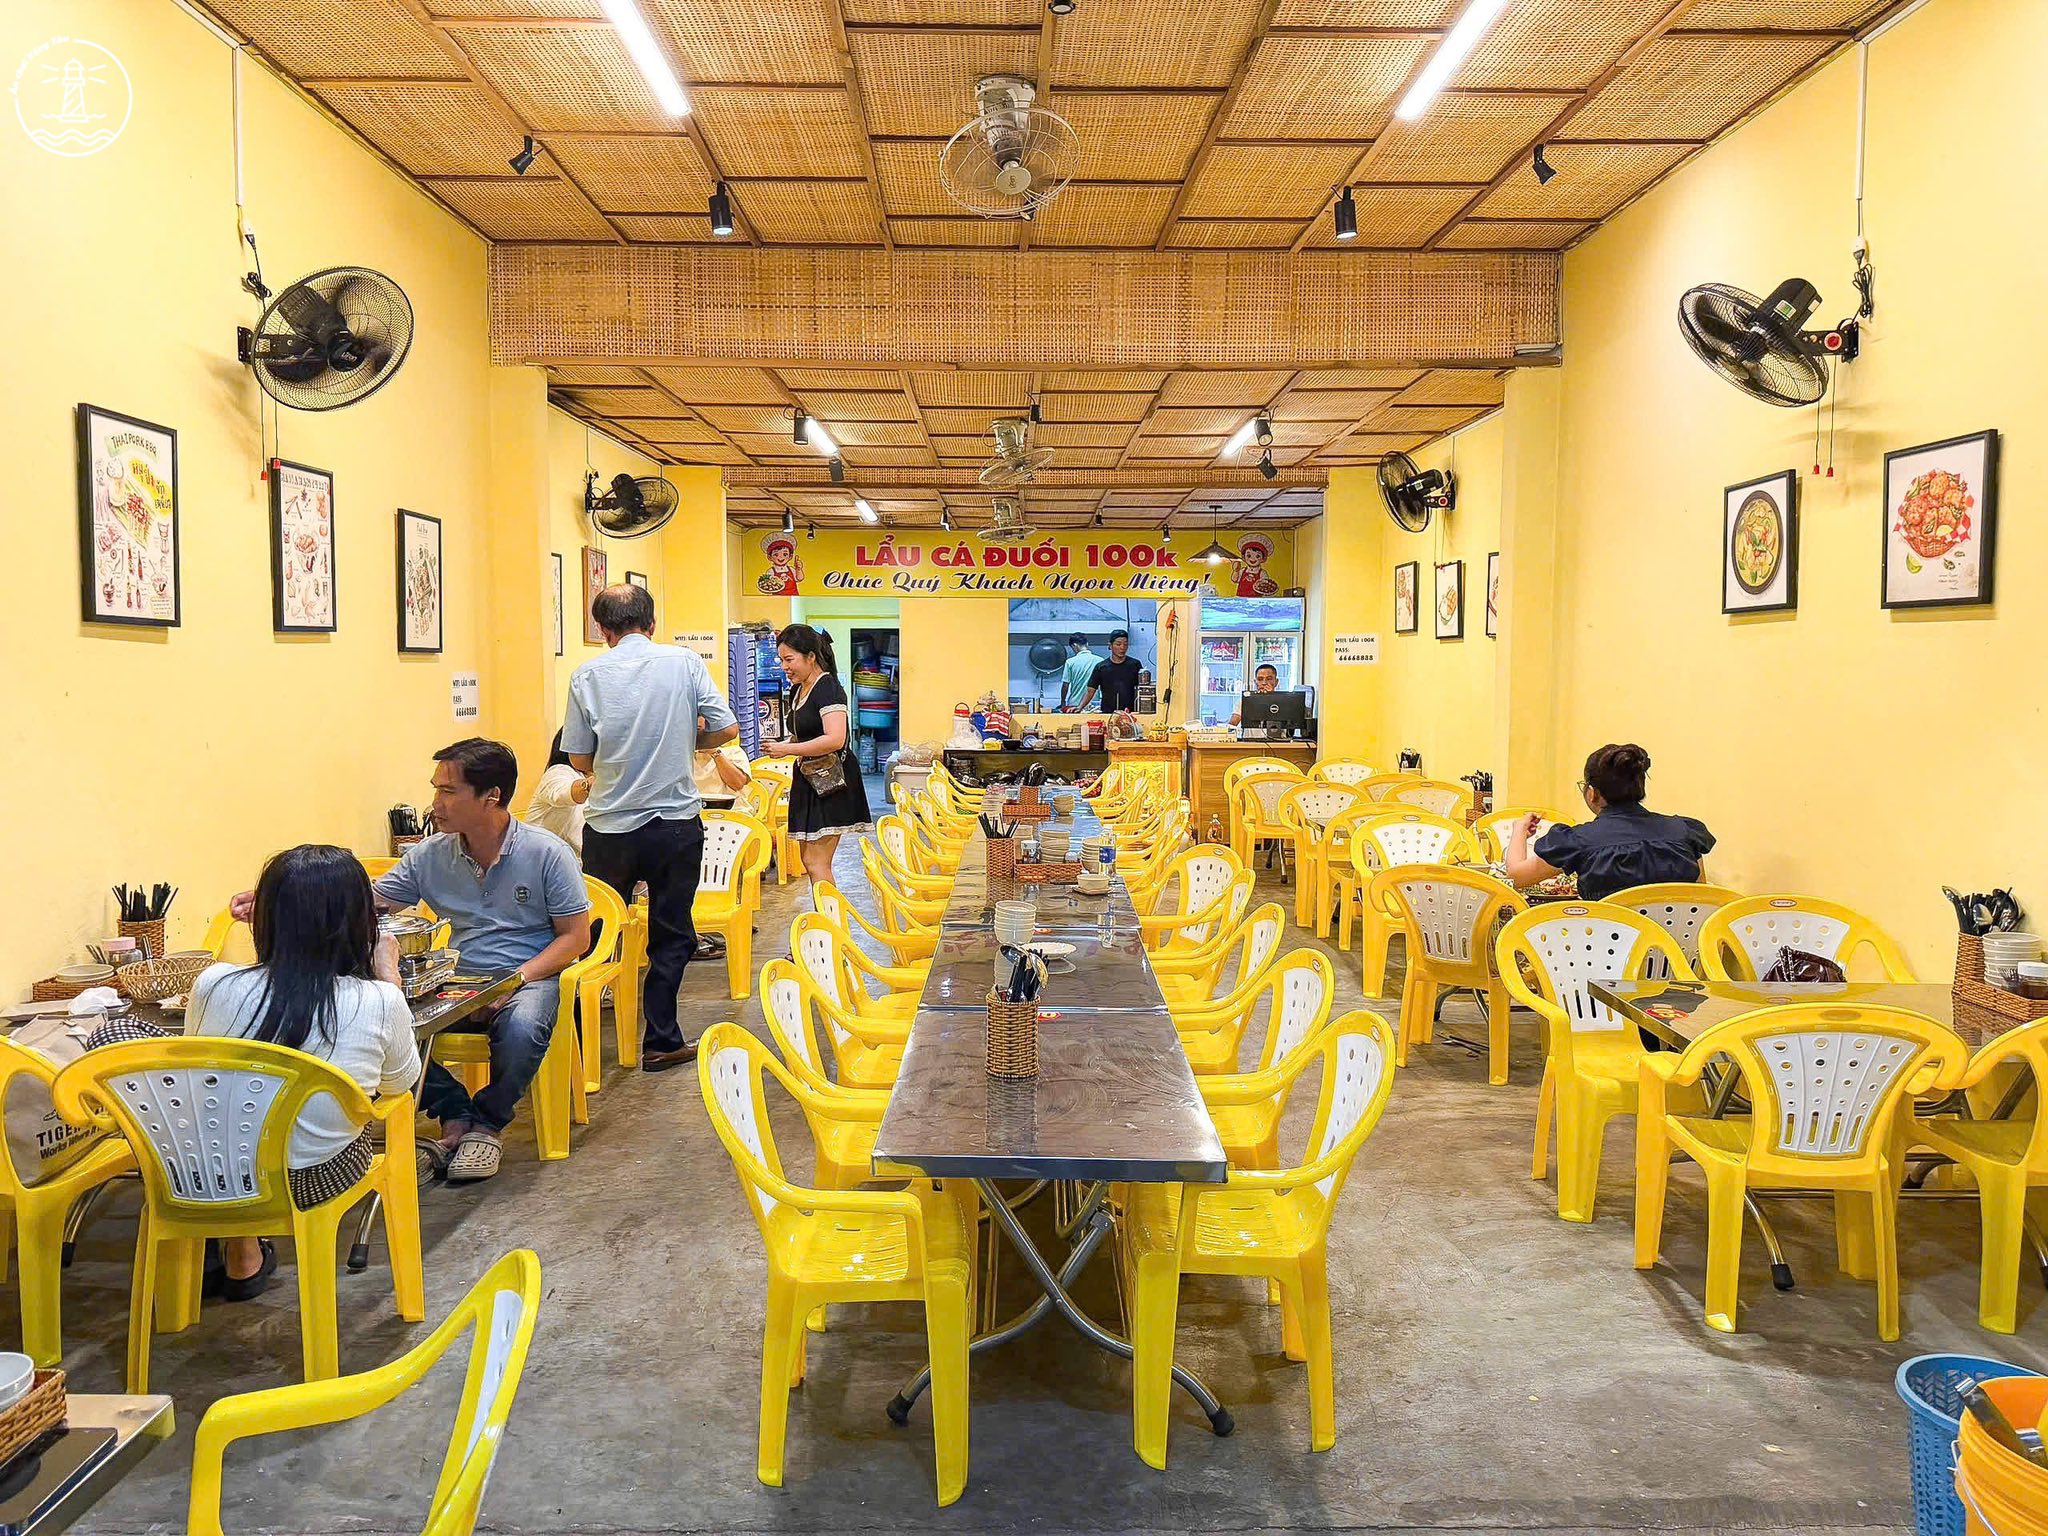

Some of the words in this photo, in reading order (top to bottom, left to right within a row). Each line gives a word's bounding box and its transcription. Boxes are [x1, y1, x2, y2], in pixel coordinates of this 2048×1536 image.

[111, 433, 129, 448] THAI
[856, 534, 921, 567] LẨU
[931, 540, 975, 567] CÁ
[983, 537, 1069, 567] ĐUỐI
[1085, 544, 1178, 568] 100k
[823, 571, 884, 589] Chúc
[892, 571, 941, 593] Quý
[949, 572, 1034, 590] Khách
[1043, 572, 1115, 593] Ngon
[1121, 572, 1212, 594] Miệng!
[40, 1140, 68, 1159] Works
